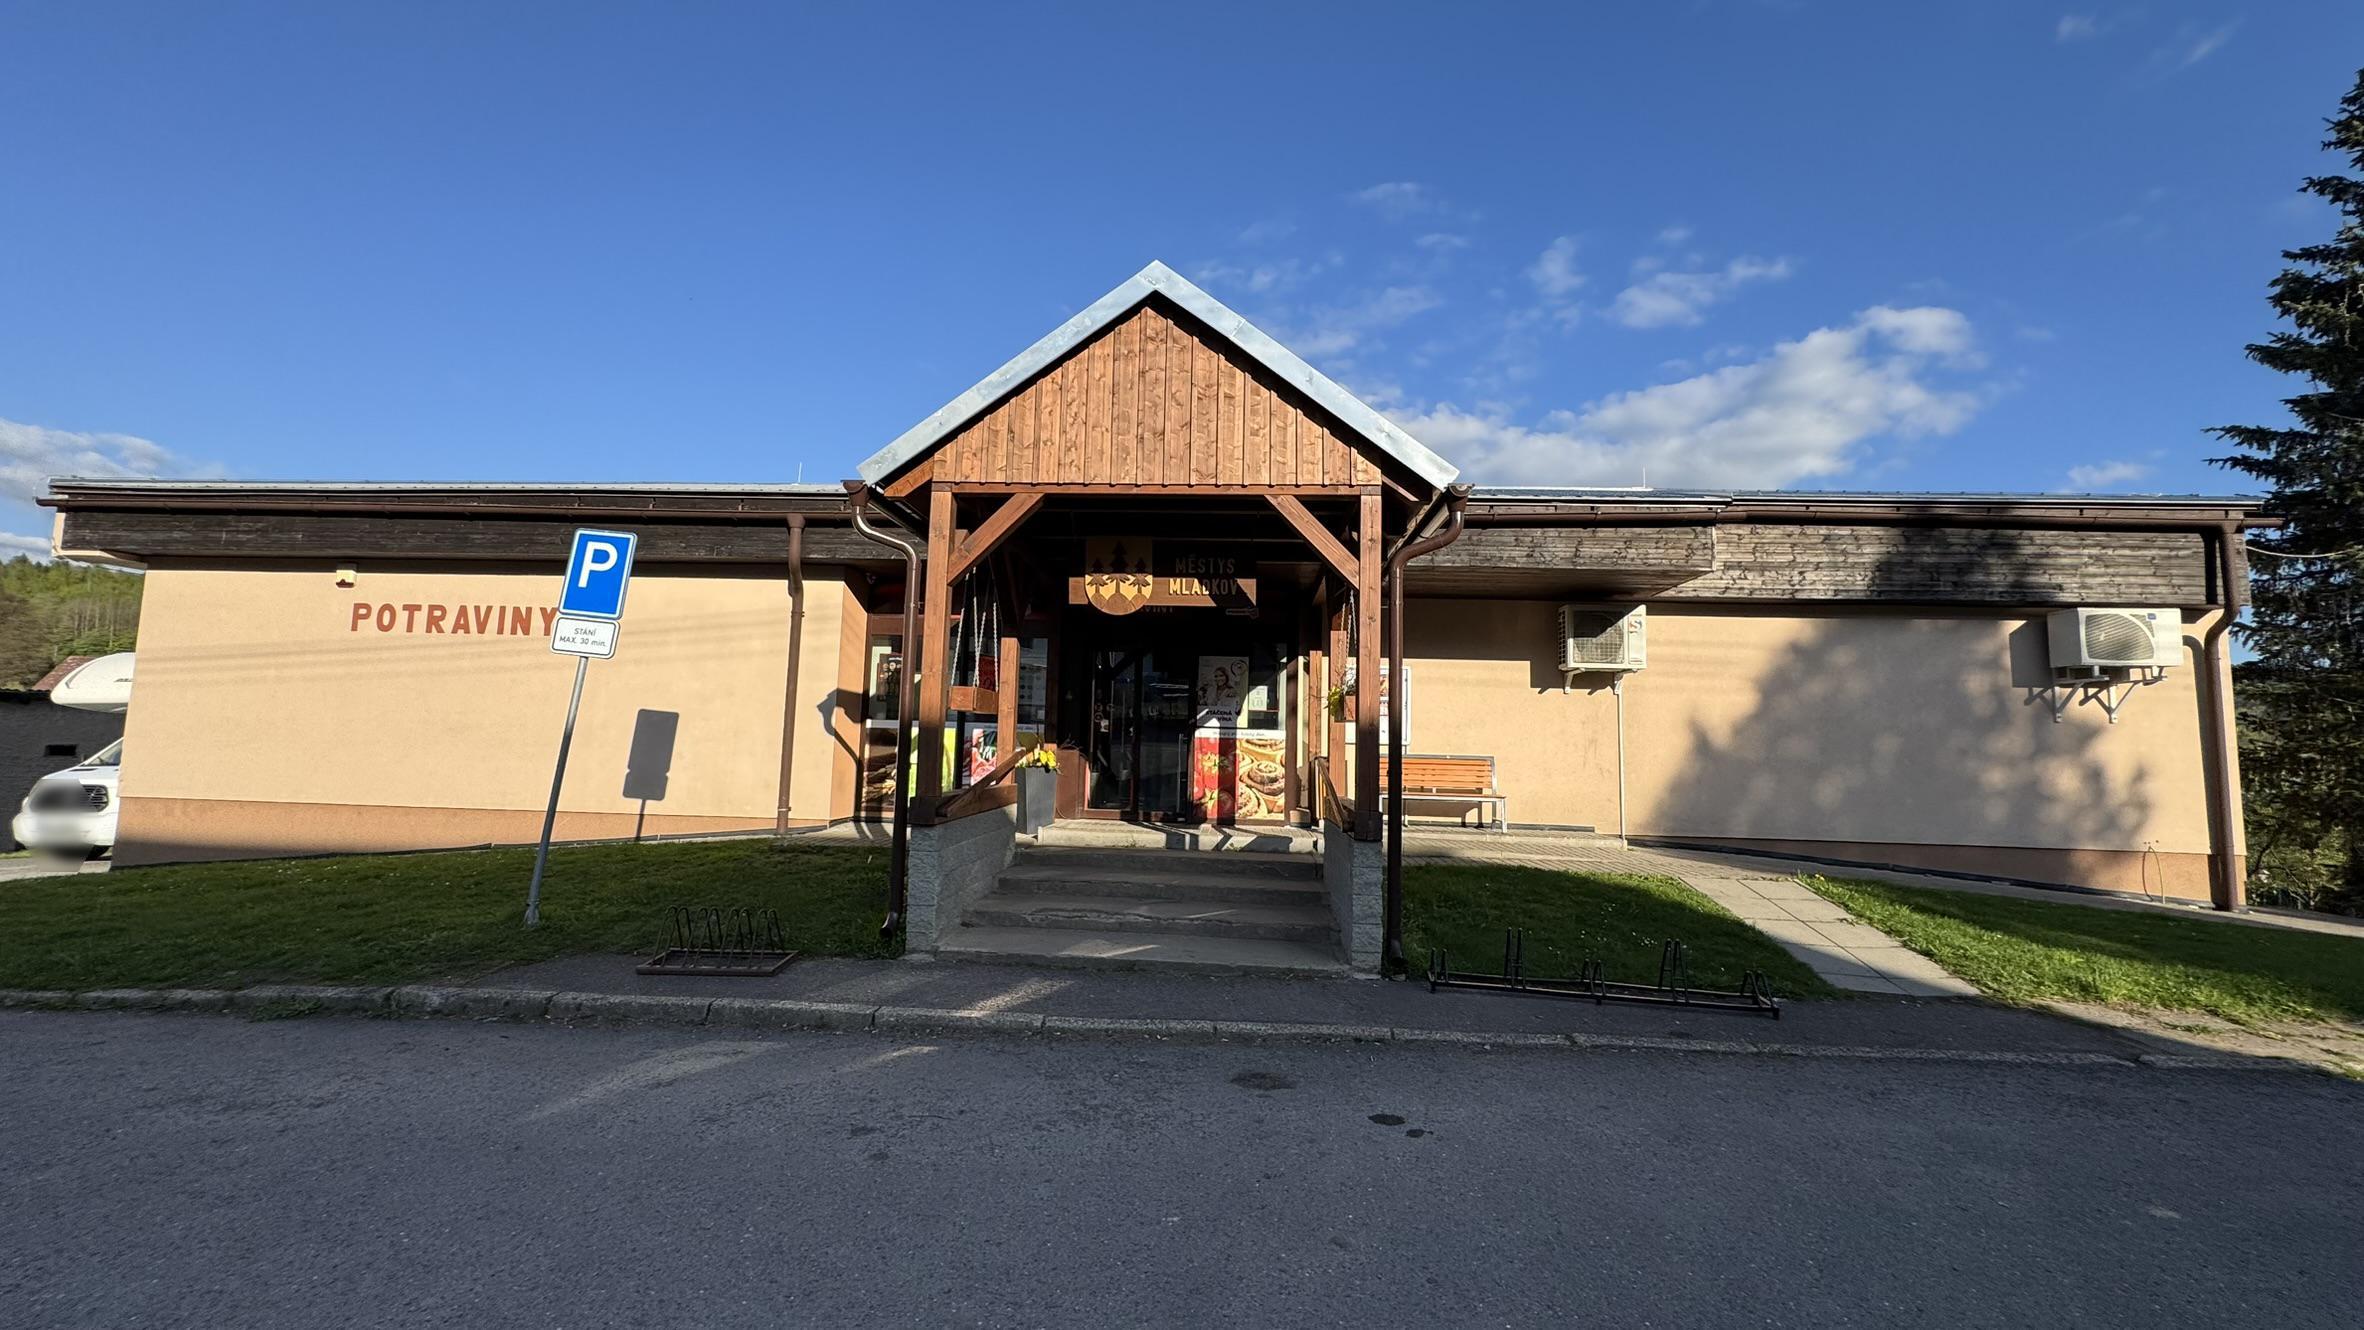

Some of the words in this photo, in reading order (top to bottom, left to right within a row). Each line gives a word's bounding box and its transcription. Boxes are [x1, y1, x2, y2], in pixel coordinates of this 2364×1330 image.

[578, 541, 618, 588] P
[1175, 554, 1235, 574] MĚSTYS
[1169, 578, 1238, 595] MLADKOV
[351, 603, 559, 636] POTRAVINY
[574, 627, 597, 637] STÁNÍ
